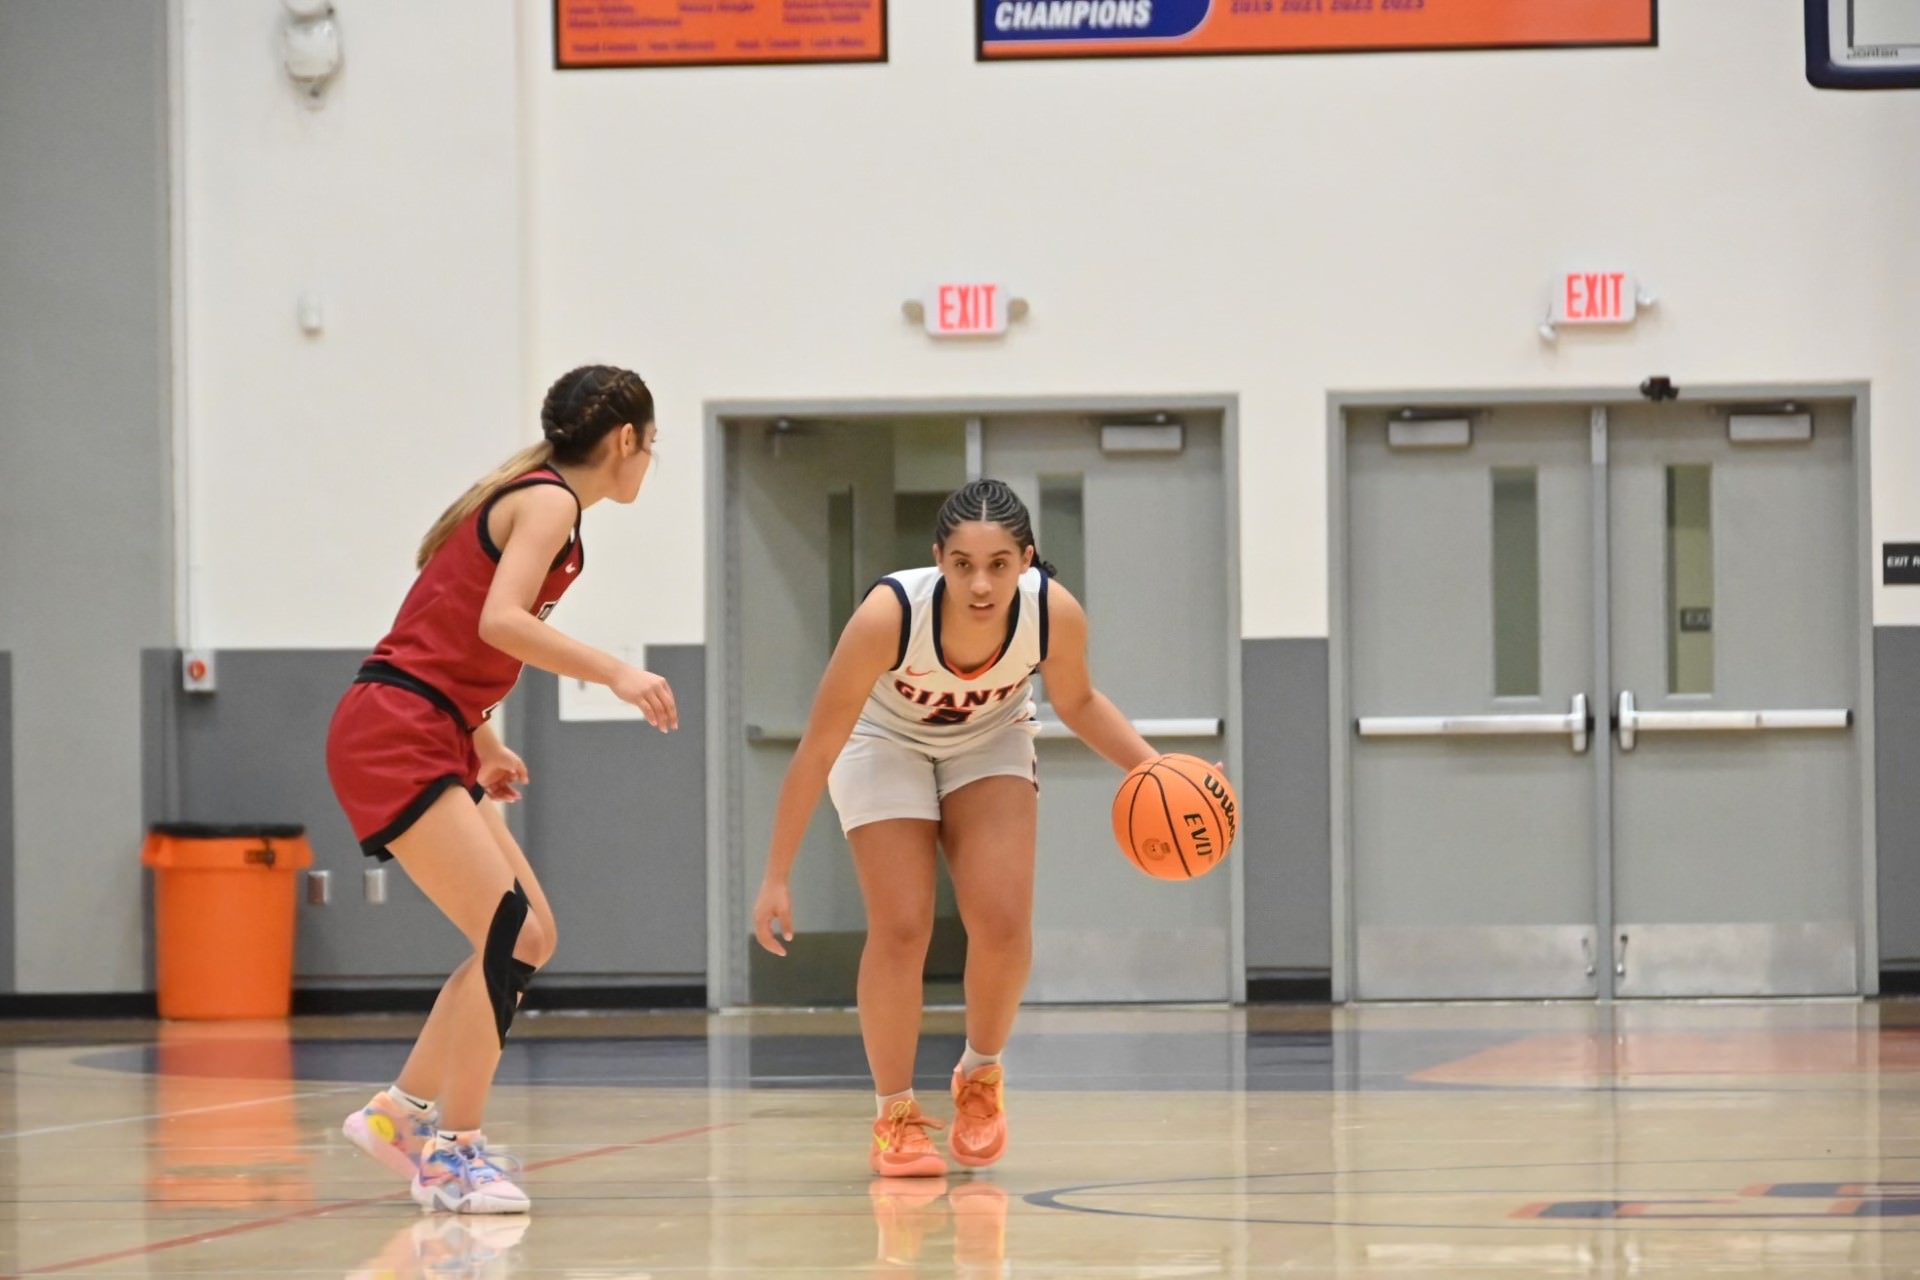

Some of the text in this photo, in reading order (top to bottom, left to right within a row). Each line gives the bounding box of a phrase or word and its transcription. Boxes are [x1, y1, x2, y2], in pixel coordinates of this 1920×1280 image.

[995, 0, 1152, 30] CHAMPIONS
[939, 284, 996, 329] EXIT
[1566, 273, 1625, 318] EXIT
[1886, 555, 1909, 568] EXIT
